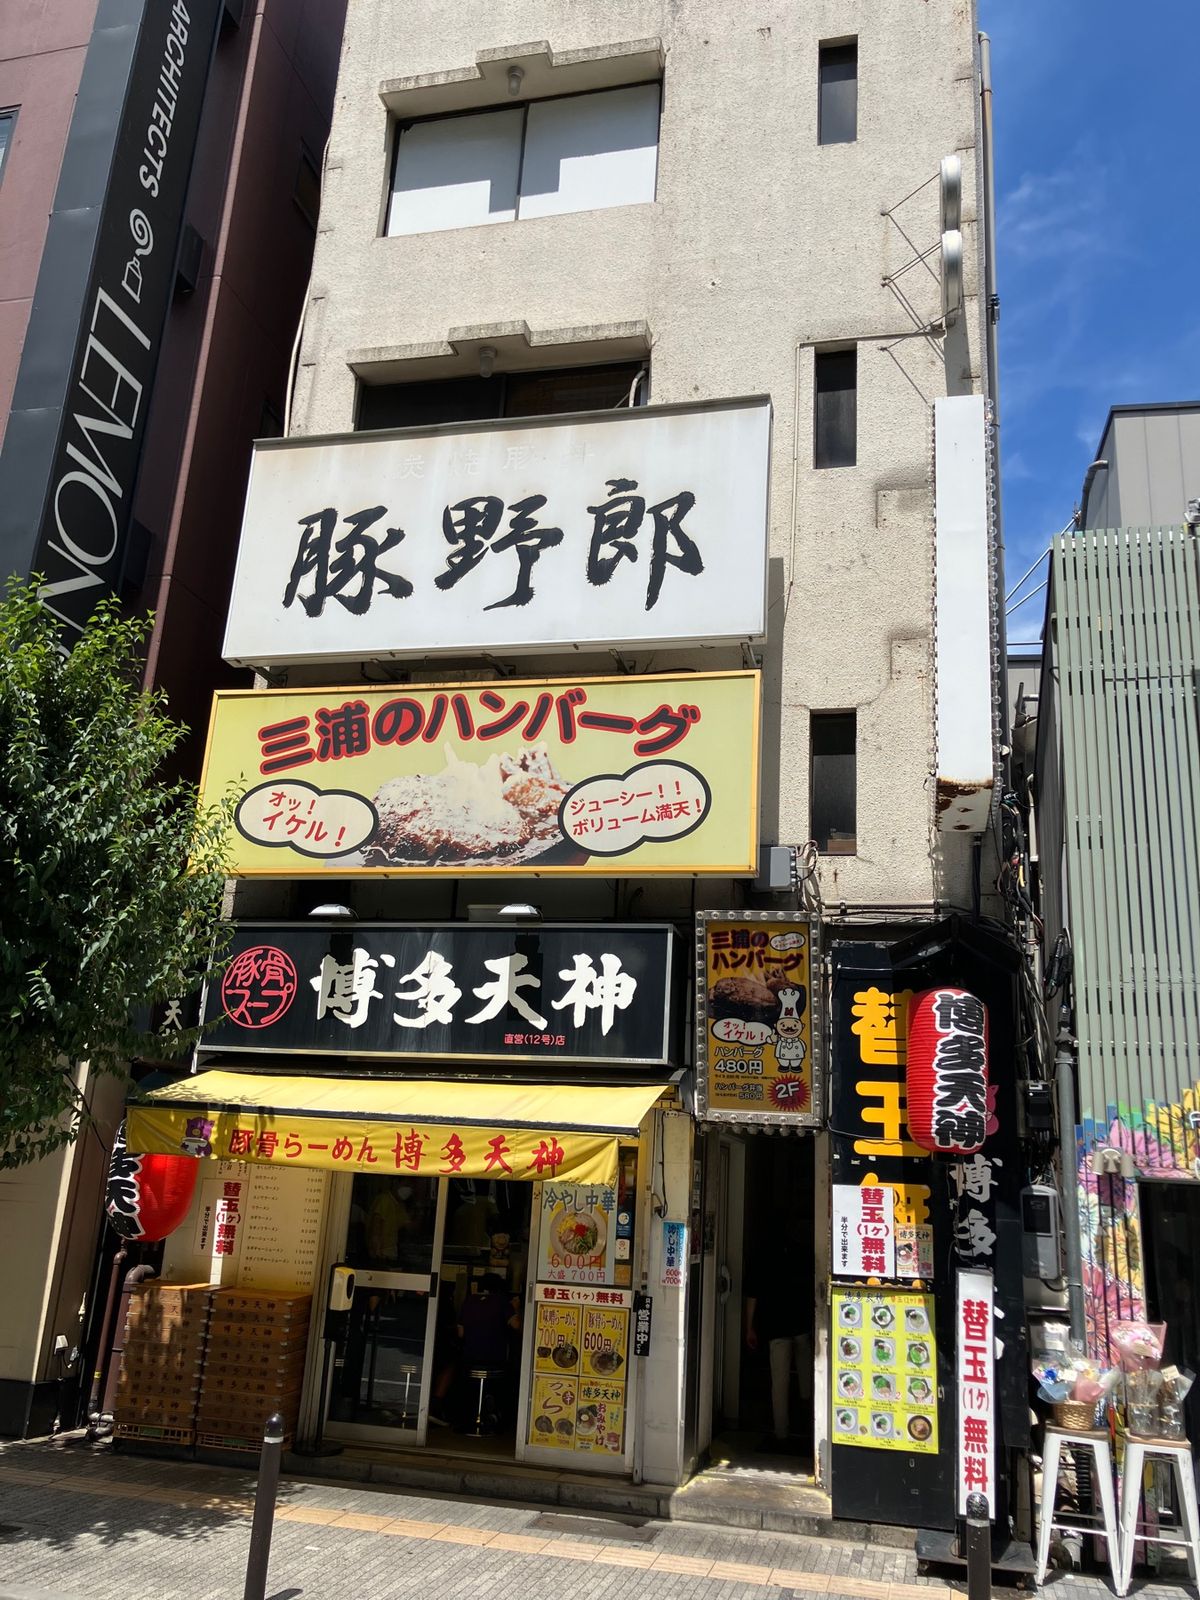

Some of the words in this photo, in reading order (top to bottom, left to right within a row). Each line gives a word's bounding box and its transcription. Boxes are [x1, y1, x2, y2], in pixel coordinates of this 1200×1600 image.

[138, 0, 192, 198] ARCHITECTS
[282, 477, 705, 618] 豚野郎
[257, 687, 703, 776] 三浦のハンバーグ
[711, 929, 769, 950] 三浦の
[225, 949, 294, 988] 豚骨
[711, 950, 804, 972] ハンバーグ
[309, 946, 639, 1037] 博多天神
[503, 1032, 566, 1047] 直営(12号)店
[714, 1045, 764, 1058] ハンバーグ
[715, 1059, 764, 1075] 480円
[933, 991, 986, 1149] 博多天神
[775, 1082, 800, 1099] 2F
[228, 1127, 378, 1165] 豚骨らーめん
[392, 1130, 565, 1176] 博多天神
[542, 1186, 616, 1214] 冷やし中華
[840, 1216, 850, 1268] 半分で出来ます
[856, 1187, 891, 1274] 替玉(1ケ)無料
[551, 1253, 603, 1271] 600円
[571, 1270, 606, 1283] 700円
[543, 1286, 625, 1305] 替玉(1ケ)無料
[583, 1331, 613, 1352] 600円
[582, 1387, 622, 1401] 博多天神
[961, 1298, 990, 1494] 替玉(1ケ)無料
